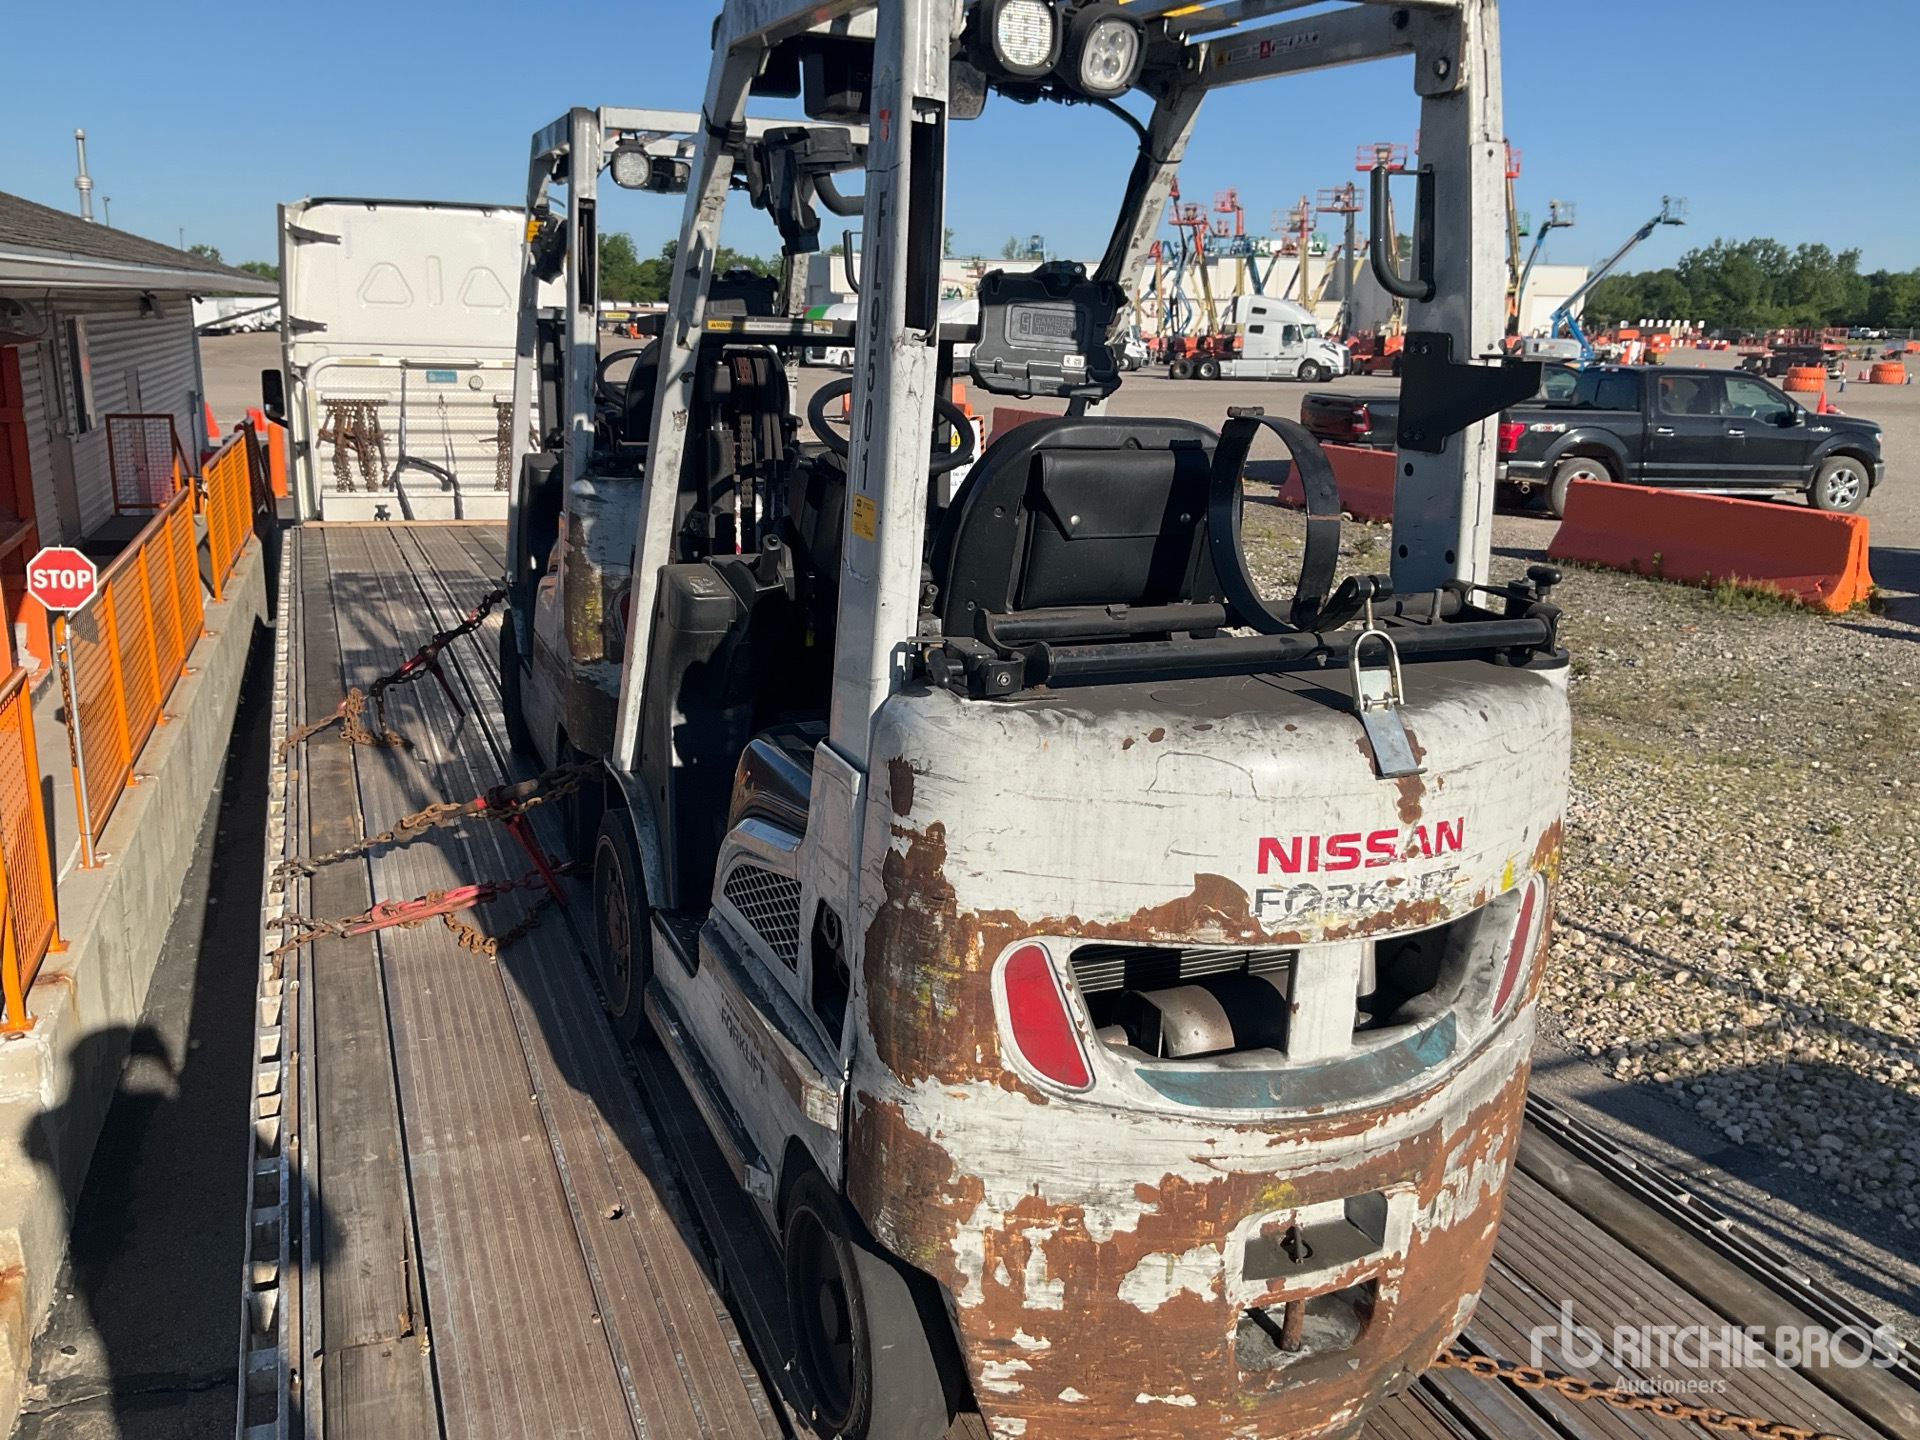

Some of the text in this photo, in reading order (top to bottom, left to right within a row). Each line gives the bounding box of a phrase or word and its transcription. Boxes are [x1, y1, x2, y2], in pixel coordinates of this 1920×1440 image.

[863, 191, 888, 490] FL95501
[1033, 314, 1074, 328] GAMBER
[1033, 325, 1074, 337] JOHNSON
[33, 569, 91, 589] STOP
[1257, 817, 1464, 874] NISSAN
[1253, 865, 1460, 918] FORKFT
[721, 1006, 765, 1084] FORKLIFT
